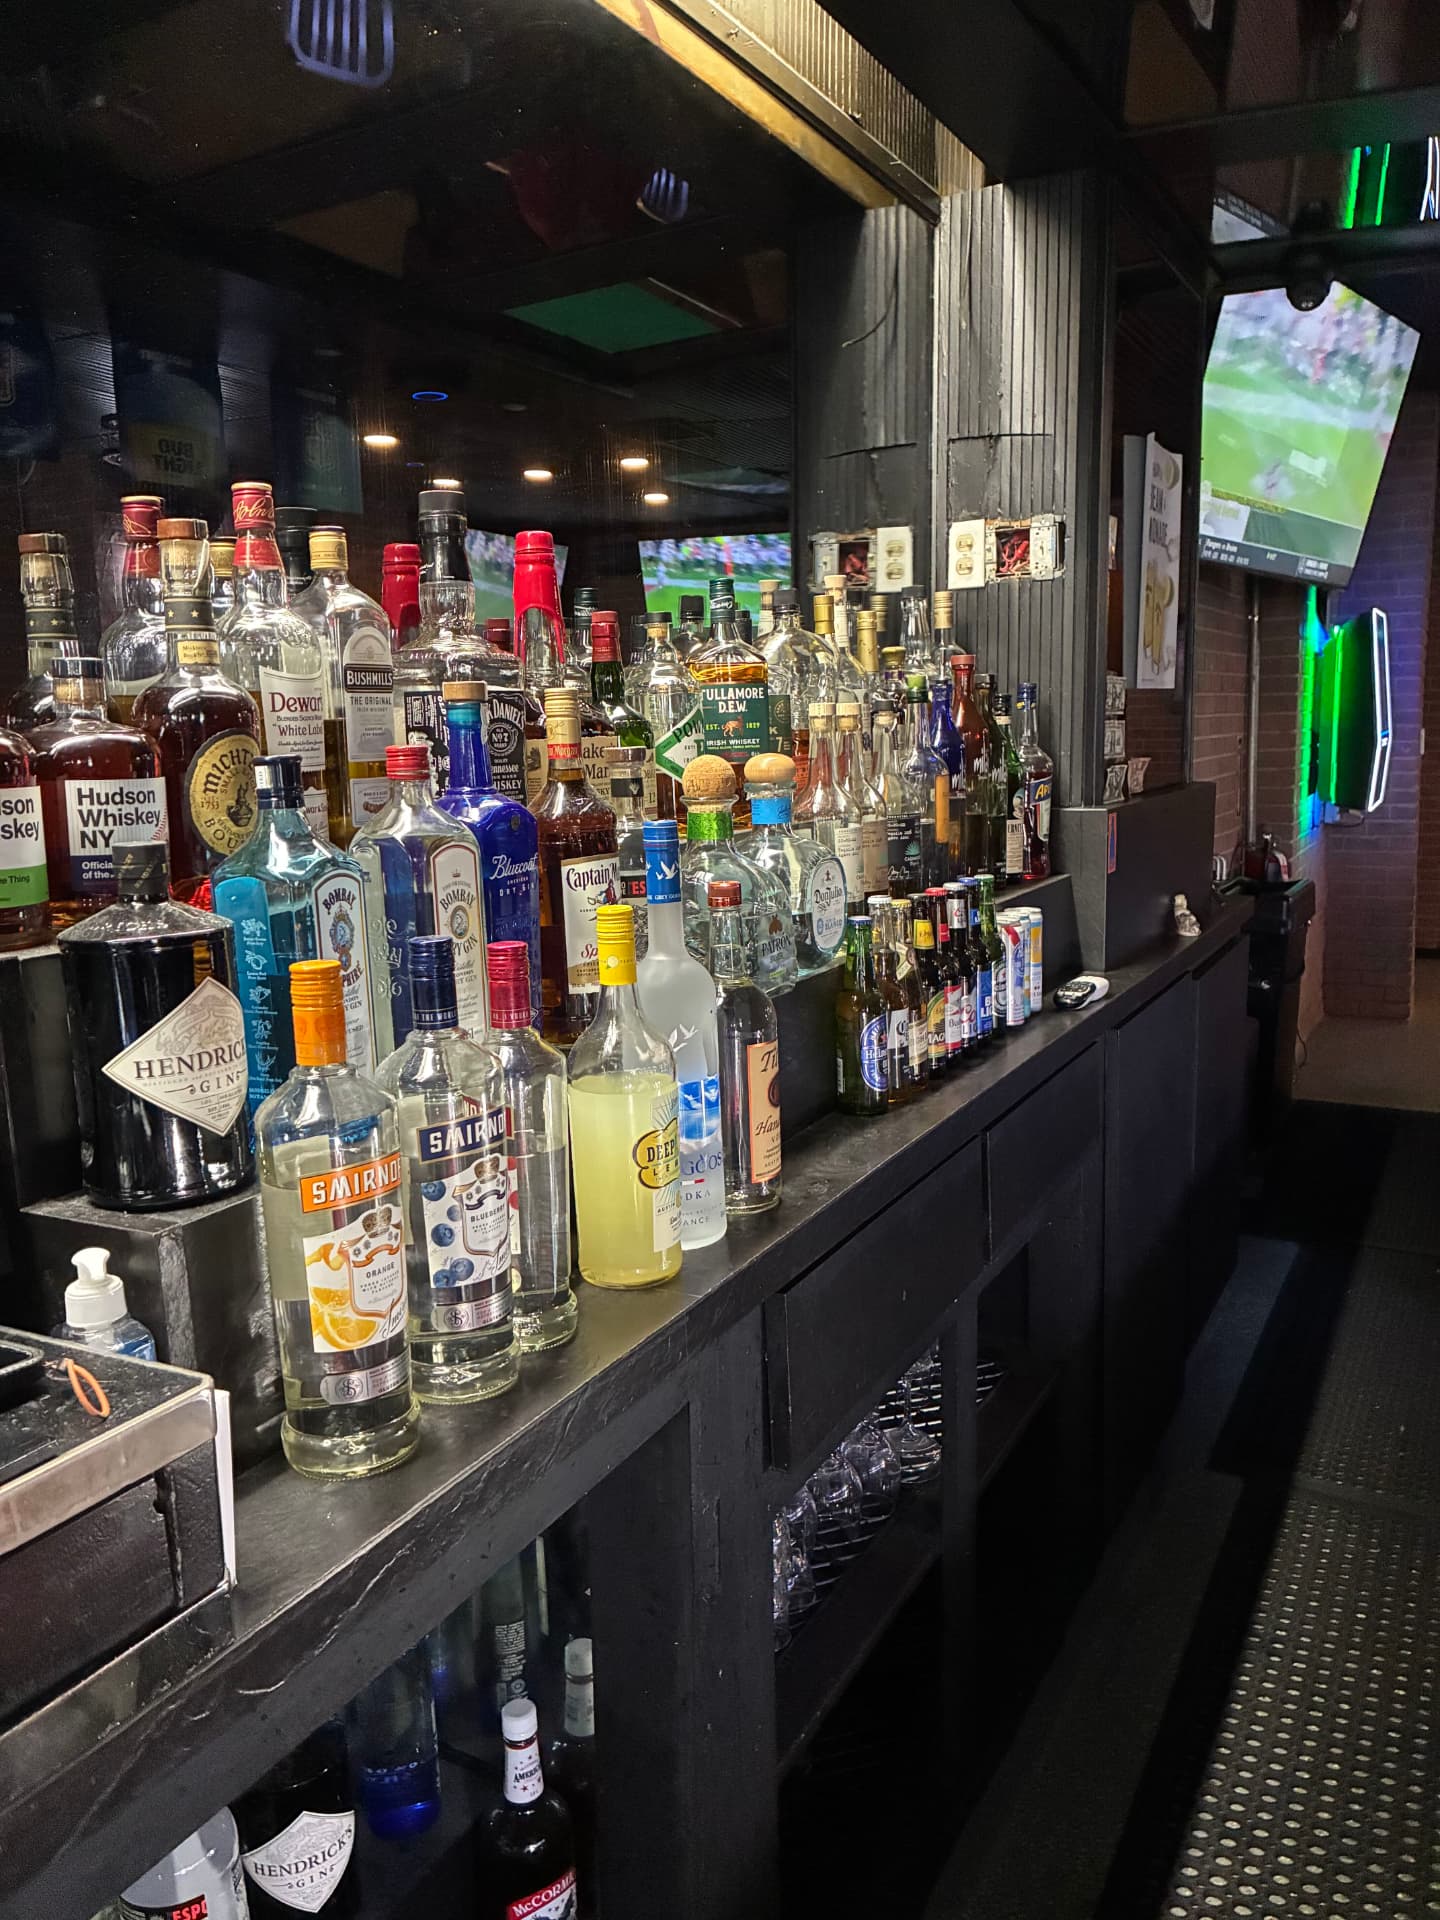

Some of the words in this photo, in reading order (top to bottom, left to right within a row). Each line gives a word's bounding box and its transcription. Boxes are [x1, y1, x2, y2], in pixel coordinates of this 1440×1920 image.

[347, 671, 392, 686] BUSHMILLS
[350, 696, 363, 705] THE
[365, 696, 392, 705] ORIGINAL
[718, 700, 748, 713] D.E.W.
[672, 716, 703, 743] POW
[583, 743, 606, 759] ake
[729, 738, 760, 746] WHISKEY
[492, 764, 519, 773] nnessee
[585, 764, 609, 779] Mar
[494, 780, 522, 790] ISKEY
[77, 786, 156, 806] Hudson
[78, 807, 161, 827] Whiskey
[0, 818, 39, 841] skey
[80, 829, 114, 849] NY
[82, 861, 113, 870] Officia
[82, 870, 93, 879] of
[93, 870, 110, 879] the
[489, 852, 538, 880] Bluecoat
[566, 864, 609, 891] Captain
[631, 880, 646, 895] ES
[322, 887, 357, 916] BOMBAY
[440, 888, 477, 912] BOMBAY
[581, 943, 599, 959] Sp
[343, 959, 364, 988] PHIRE
[436, 1010, 457, 1021] WORL
[928, 1033, 945, 1043] MAG
[200, 1074, 235, 1093] GIN
[430, 1112, 505, 1154] SMIRNO
[647, 1140, 675, 1162] DEEP
[686, 1189, 711, 1201] DKA
[683, 1215, 709, 1226] ANCE
[366, 1261, 395, 1279] ORANGE
[253, 1823, 353, 1877] HENDRICK'S
[296, 1868, 328, 1888] GIN
[512, 1871, 575, 1918] McCORM
